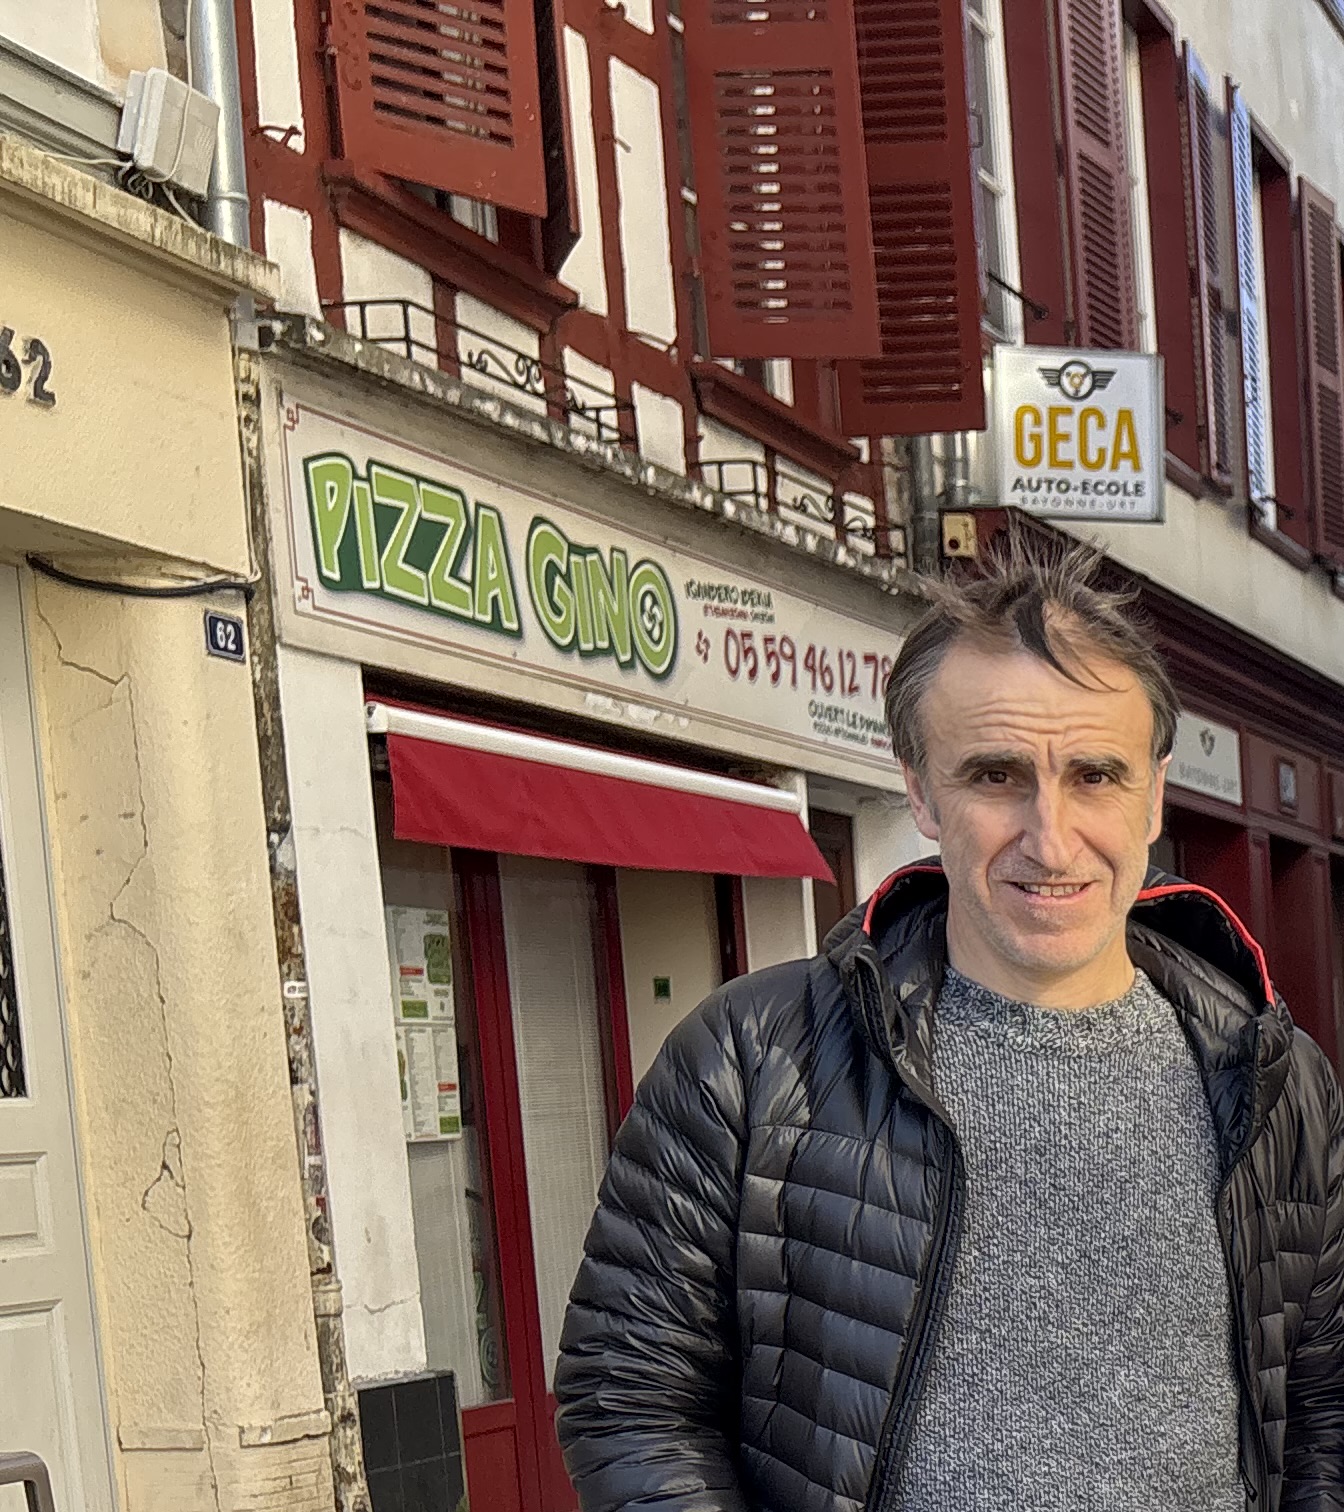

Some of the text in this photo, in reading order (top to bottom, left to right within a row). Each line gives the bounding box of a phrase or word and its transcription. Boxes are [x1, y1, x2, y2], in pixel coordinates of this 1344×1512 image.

[0, 325, 56, 404] 62
[1013, 404, 1143, 473] GECA
[304, 453, 678, 680] PIZZA GINO
[216, 619, 238, 652] 62
[724, 627, 758, 683] 05
[763, 634, 798, 689] 59
[804, 643, 835, 694] 46
[838, 648, 861, 697] 12
